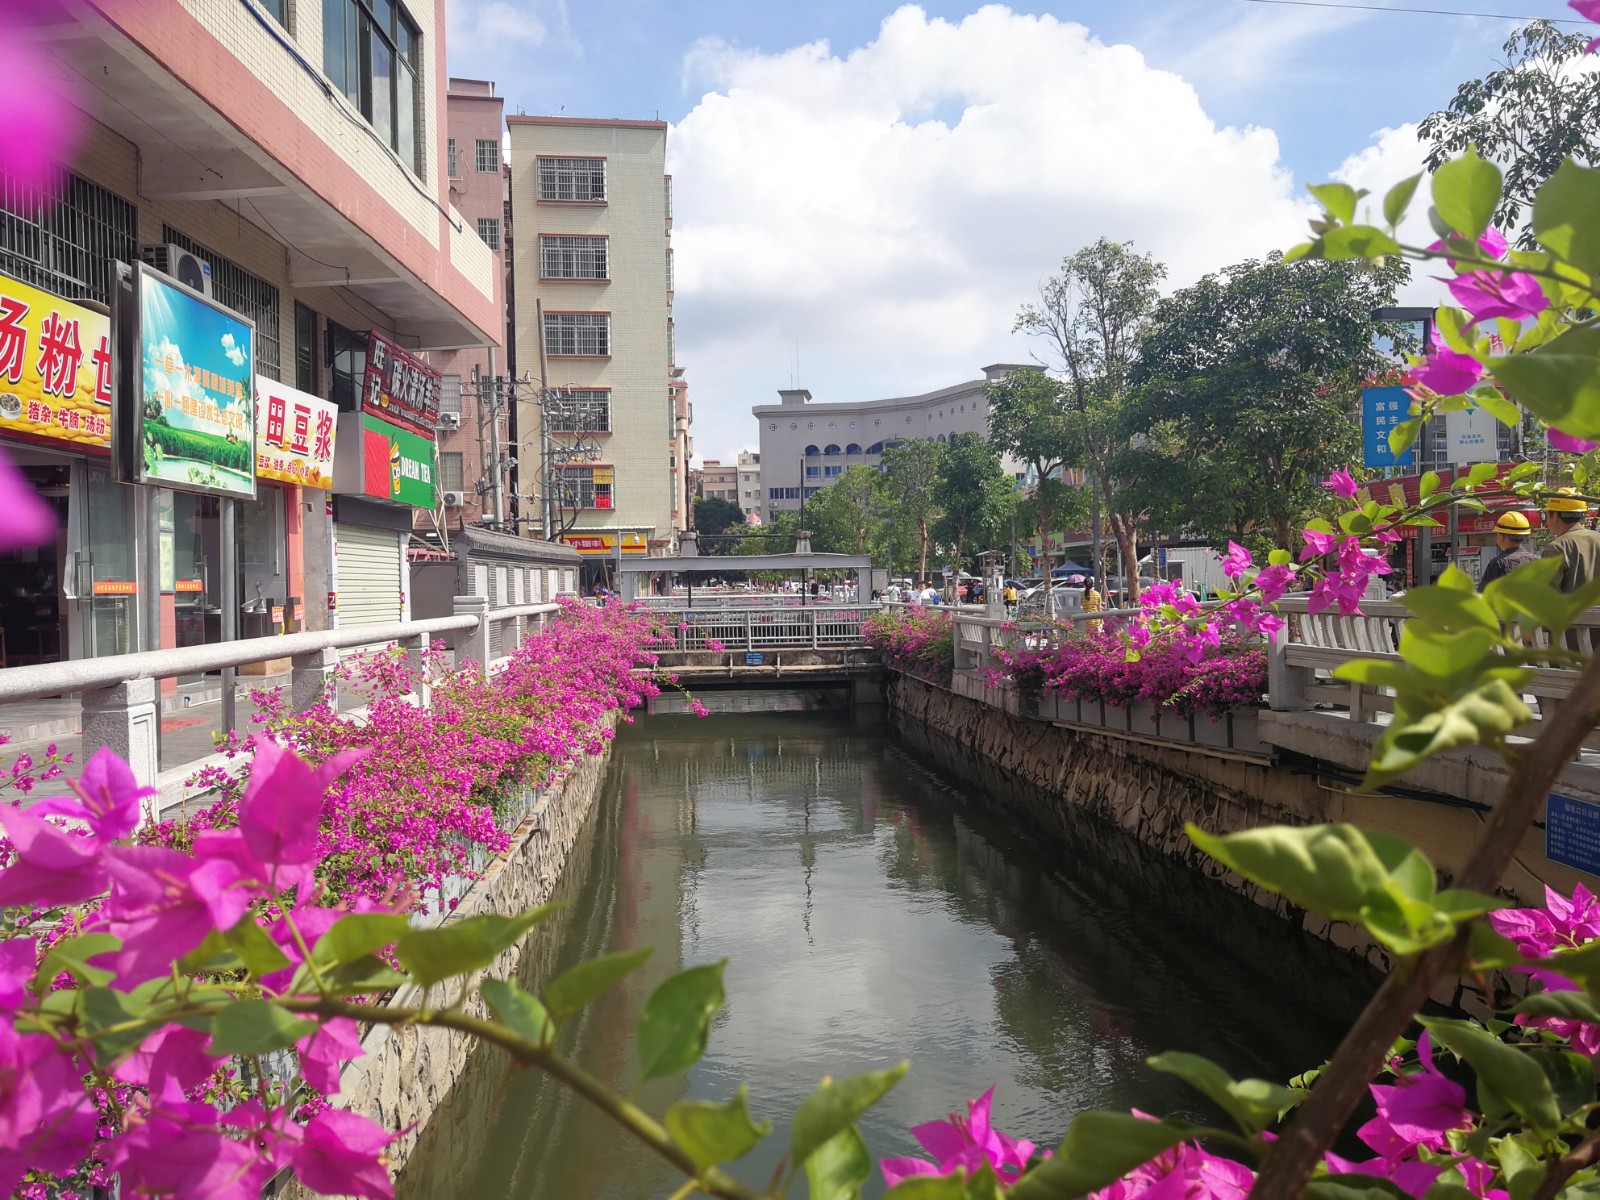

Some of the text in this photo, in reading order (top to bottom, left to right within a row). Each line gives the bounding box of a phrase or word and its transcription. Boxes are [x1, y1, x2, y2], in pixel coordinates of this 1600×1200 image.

[28, 401, 106, 435] 猪杂 牛腩 汤粉
[155, 390, 243, 430] 一心一意建设水生态文明
[1376, 401, 1398, 412] 富强
[256, 388, 333, 459] 田豆浆
[1376, 416, 1398, 426] 民主
[258, 455, 271, 470] 豆浆
[401, 456, 420, 481] DREAM
[421, 462, 431, 484] TEA
